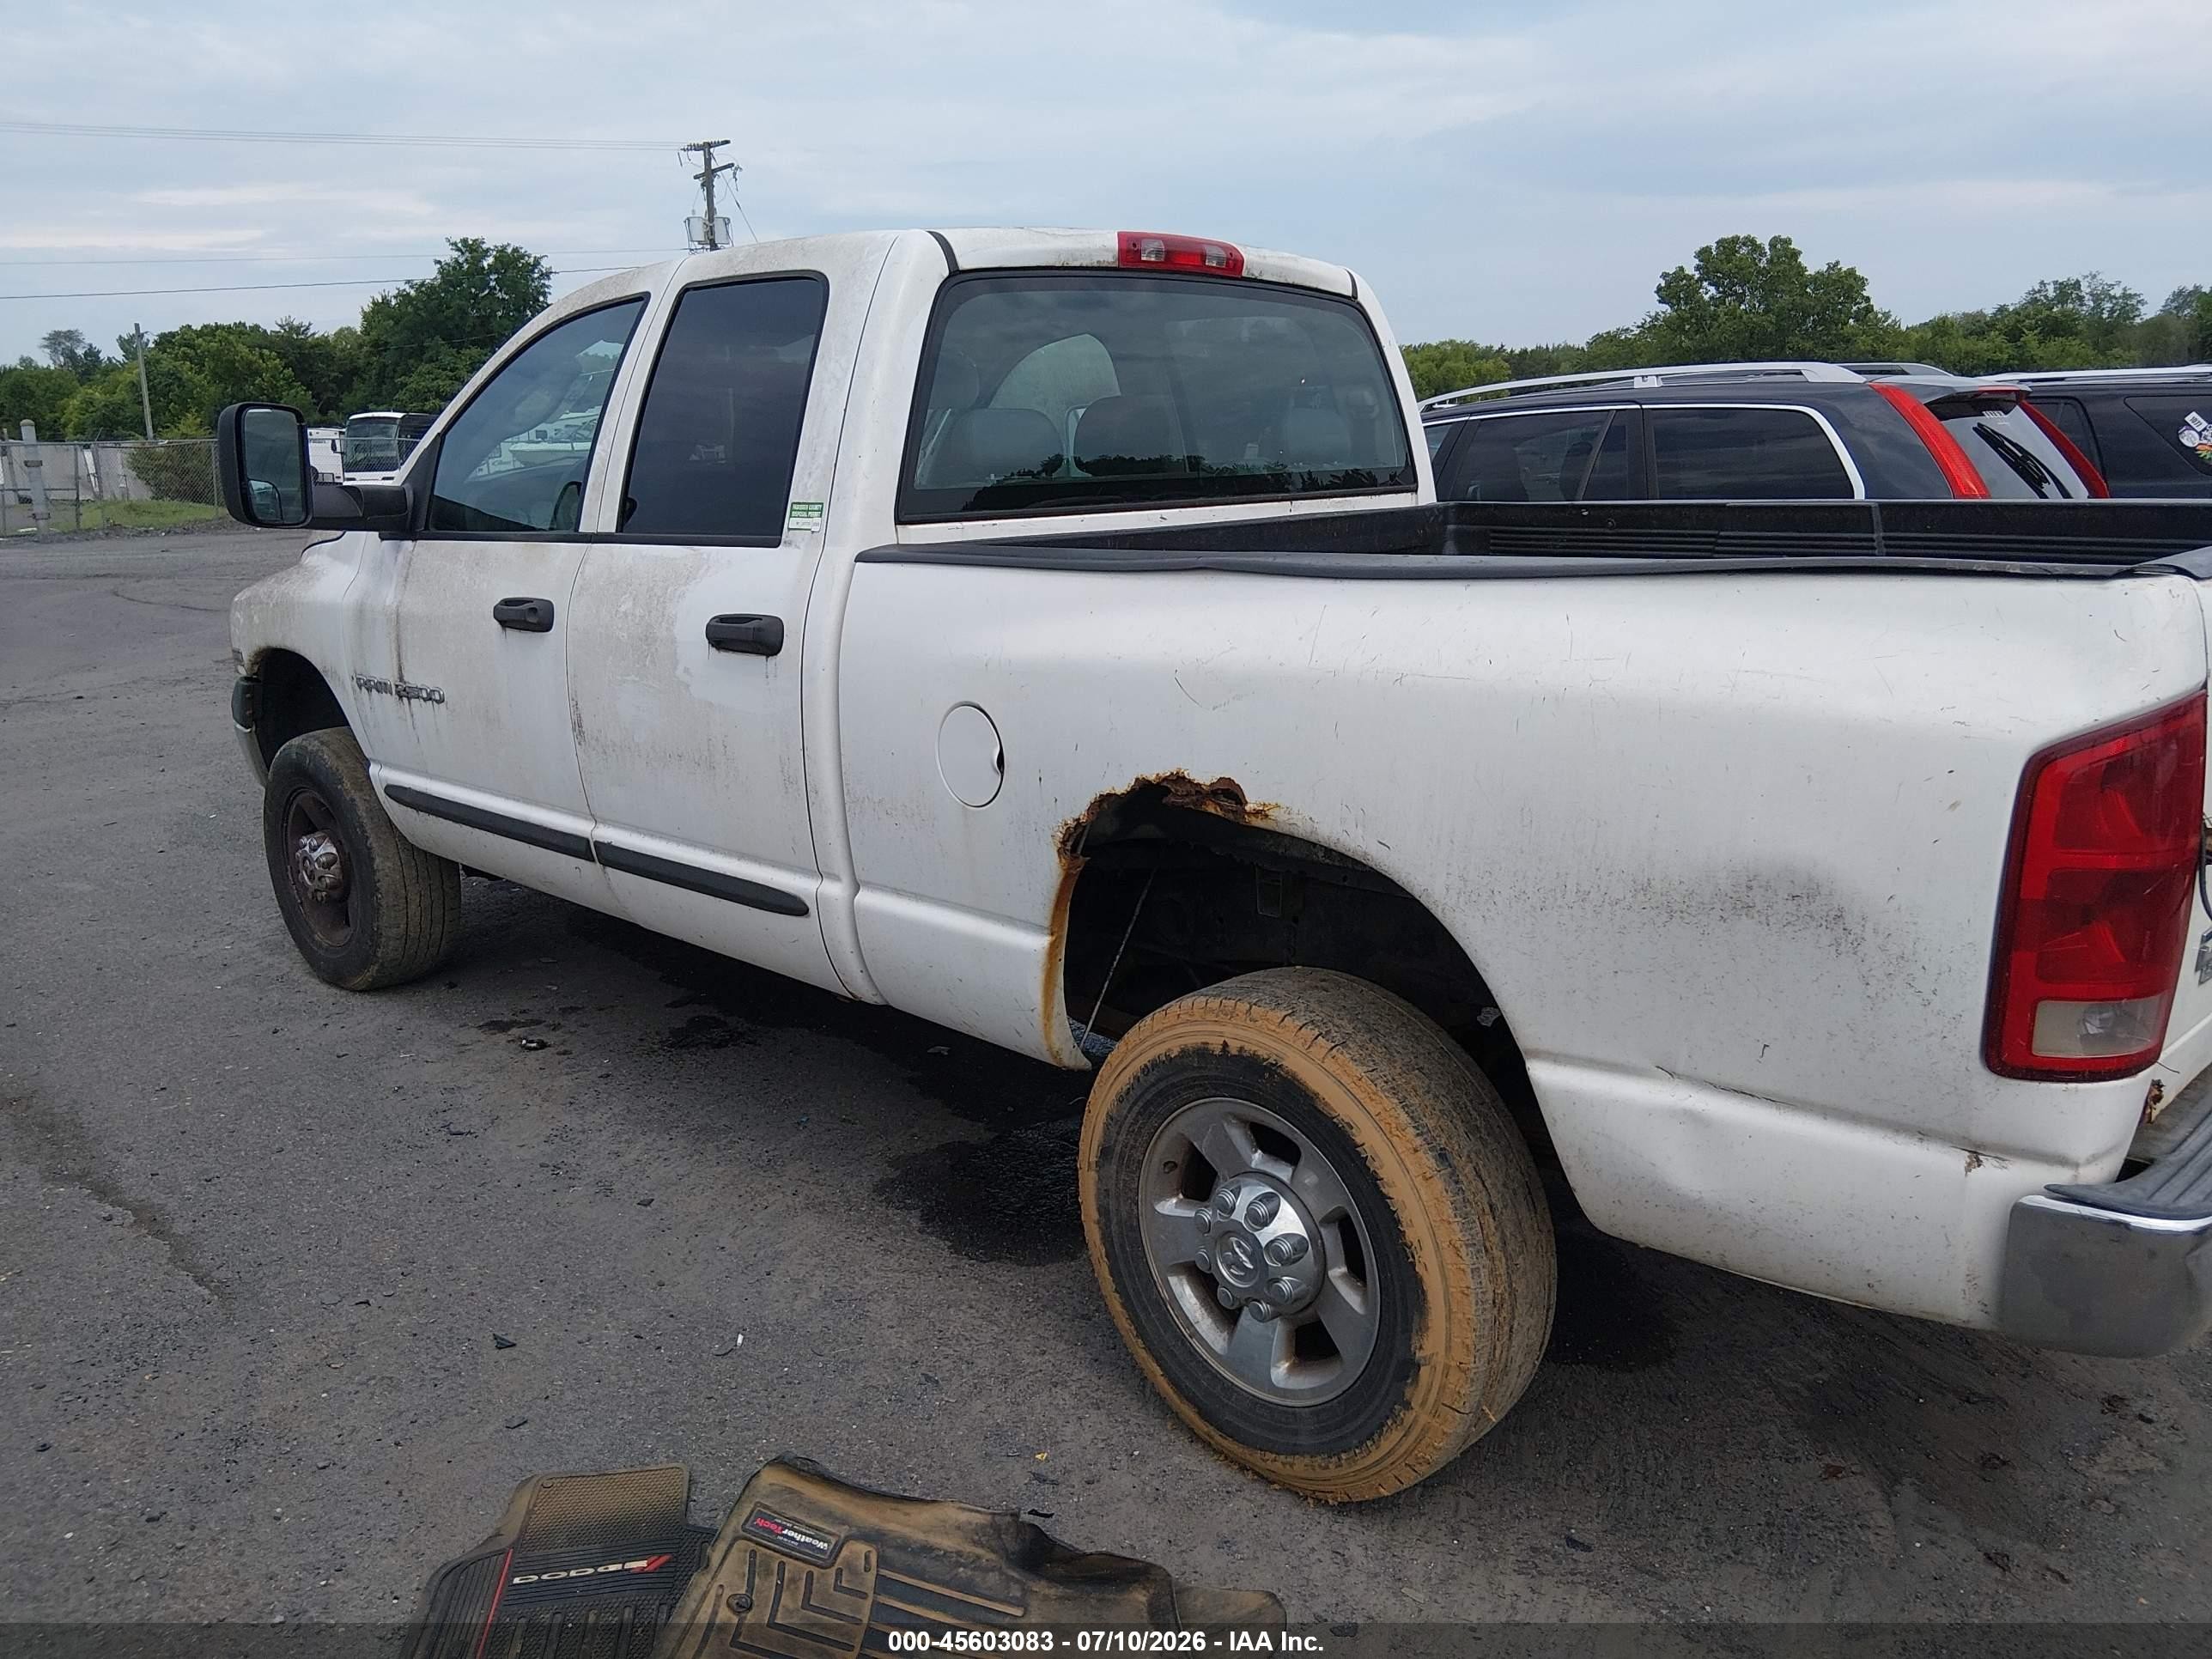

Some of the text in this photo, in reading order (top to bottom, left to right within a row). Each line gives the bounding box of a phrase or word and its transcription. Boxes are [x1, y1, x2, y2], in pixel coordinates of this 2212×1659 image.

[395, 682, 445, 705] 2500
[754, 1516, 829, 1551] WeatherTech
[513, 1559, 648, 1584] DODGE
